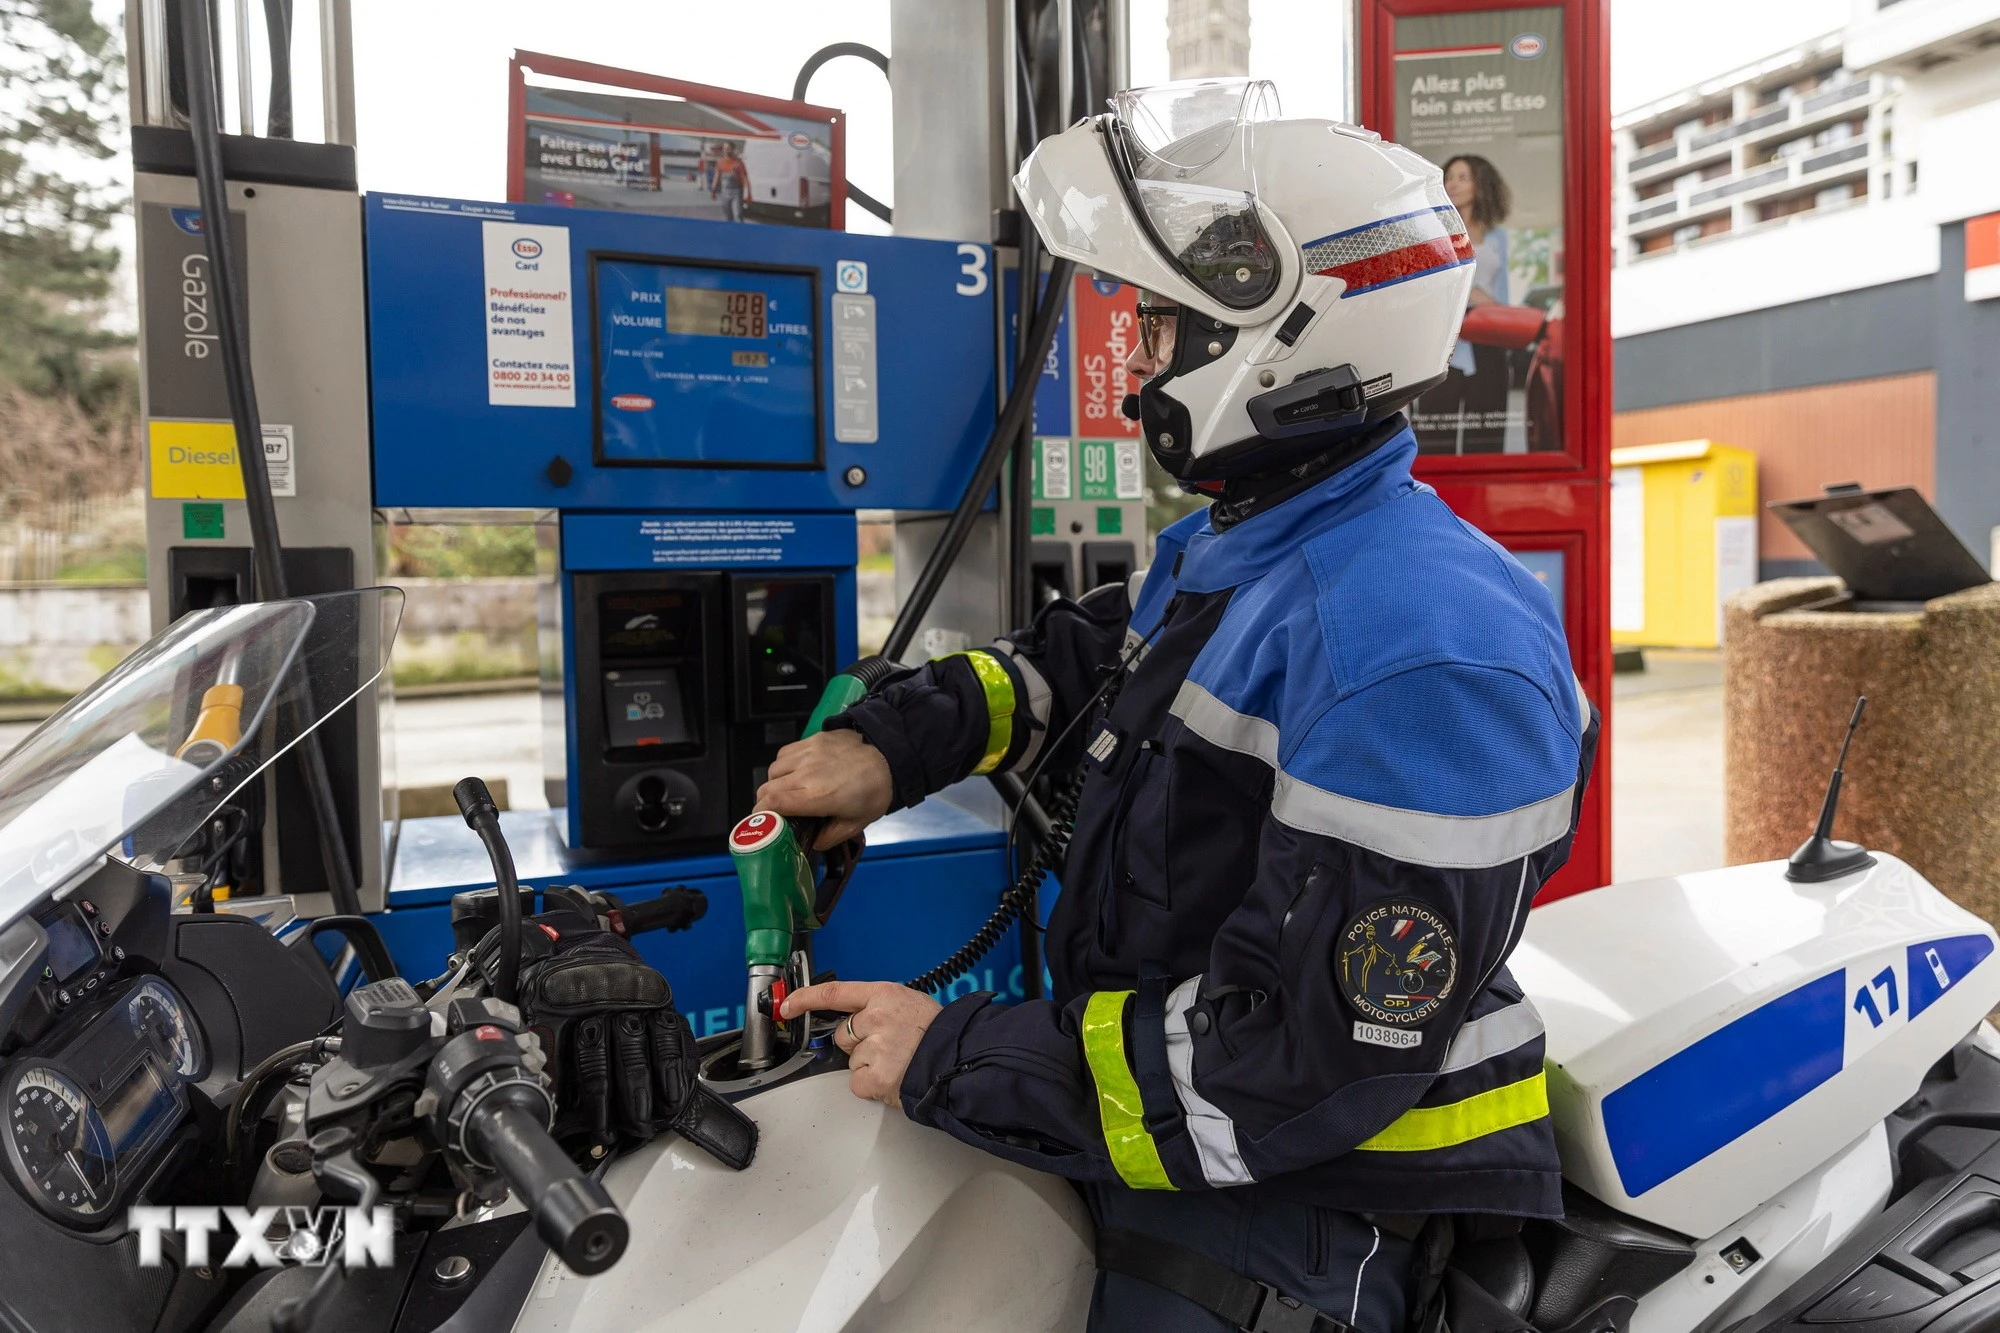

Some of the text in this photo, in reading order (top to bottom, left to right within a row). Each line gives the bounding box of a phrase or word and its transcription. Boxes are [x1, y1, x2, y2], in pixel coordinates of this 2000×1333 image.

[1411, 72, 1506, 96] Allez plus
[1411, 92, 1547, 117] loin avec Esso
[539, 134, 639, 158] Faites-en plus
[540, 152, 572, 167] avec
[575, 153, 609, 170] Esso
[516, 243, 539, 253] Esso
[515, 261, 539, 271] Card
[956, 243, 988, 297] 3
[490, 288, 567, 300] Professionnel?
[631, 291, 662, 304] PRIX
[181, 253, 220, 359] Gazole
[491, 302, 546, 314] Bénéficiez
[491, 315, 526, 325] de nos
[613, 314, 809, 337] VOLUME 0.58 LITRES
[491, 328, 545, 339] avantages
[492, 359, 570, 370] Contactez nous
[493, 371, 521, 381] 0800
[524, 372, 538, 381] 20
[556, 373, 570, 382] 00
[1084, 353, 1107, 419] SP98
[1300, 403, 1318, 413] cardo
[168, 446, 236, 465] Diesel
[265, 443, 282, 454] B7
[1084, 445, 1107, 483] 98
[1348, 905, 1452, 946] POLICE NATIONALE
[1853, 965, 1899, 1028] 17
[1353, 994, 1440, 1023] MOTOCYCLISTE
[1357, 1025, 1418, 1046] 1038964
